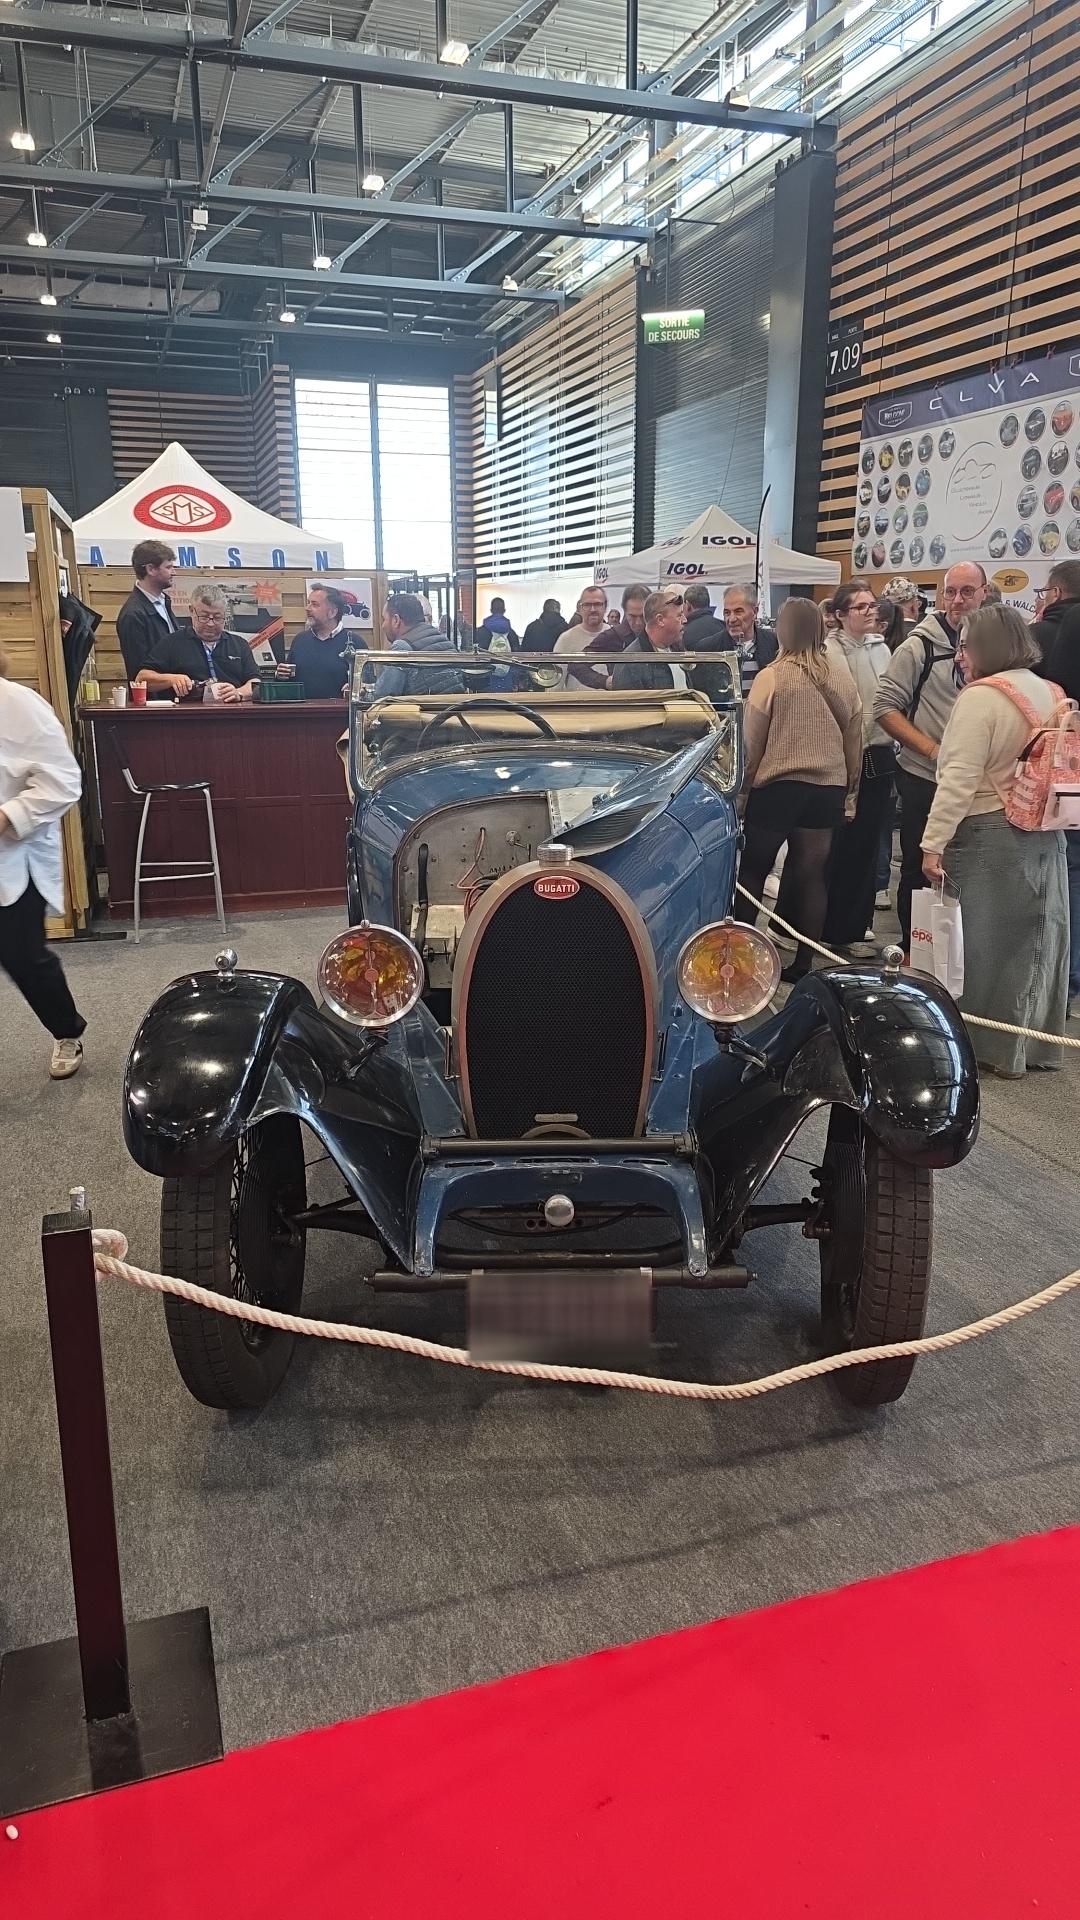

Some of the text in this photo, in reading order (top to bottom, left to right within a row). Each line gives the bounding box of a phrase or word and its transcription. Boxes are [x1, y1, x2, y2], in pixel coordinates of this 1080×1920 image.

[659, 316, 690, 328] SORTIE
[648, 328, 700, 342] DE SECOURS
[830, 343, 860, 375] 7.09
[162, 502, 204, 523] SMS
[702, 536, 757, 546] IGOL
[666, 562, 706, 575] IGOL
[538, 884, 575, 893] BUGATTI
